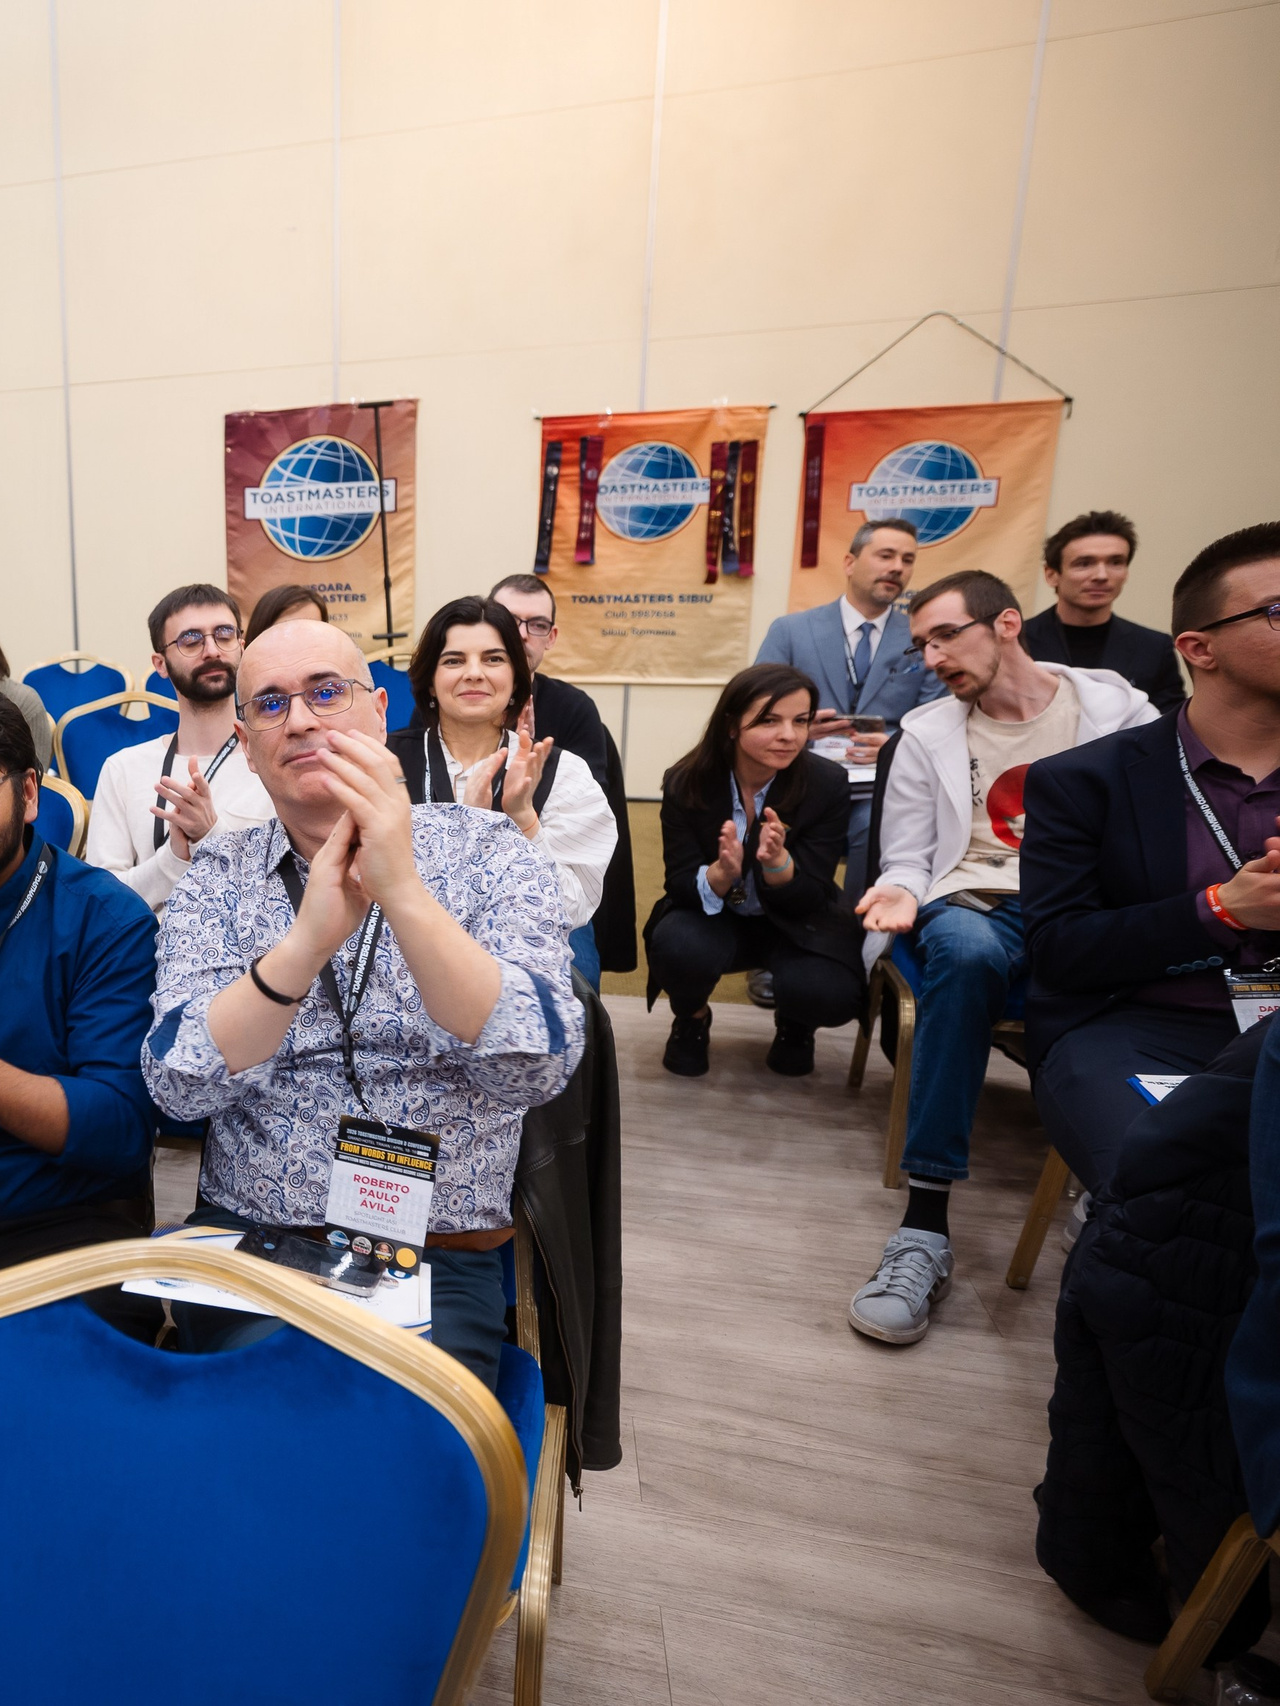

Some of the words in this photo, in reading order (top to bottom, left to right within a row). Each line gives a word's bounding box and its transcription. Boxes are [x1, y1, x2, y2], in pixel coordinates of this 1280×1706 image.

[250, 484, 390, 504] TOASTMASTERS
[598, 481, 710, 494] OASTMASTERS
[857, 482, 992, 498] TOASTMASTERS
[264, 500, 374, 514] INTERNATIONAL
[310, 582, 352, 592] SOARA
[322, 594, 366, 602] ASTERS
[571, 594, 674, 604] TOASTMASTERS
[678, 594, 714, 603] SIBIU
[605, 610, 628, 618] Club
[1204, 807, 1221, 831] DIVISION
[1216, 829, 1243, 869] TOASTMASTERS
[20, 874, 42, 912] TOASTMASTERS
[352, 944, 370, 994] TOASTMASTERS
[363, 916, 378, 944] DIVISION
[340, 1142, 360, 1153] FROM
[361, 1147, 386, 1160] WORDS
[386, 1153, 396, 1162] TO
[397, 1155, 433, 1170] INFLUENCE
[353, 1174, 410, 1194] ROBERTO
[360, 1188, 400, 1203] PAULO
[360, 1199, 396, 1214] ÁVILA
[345, 1216, 390, 1230] TOASTMASTERS
